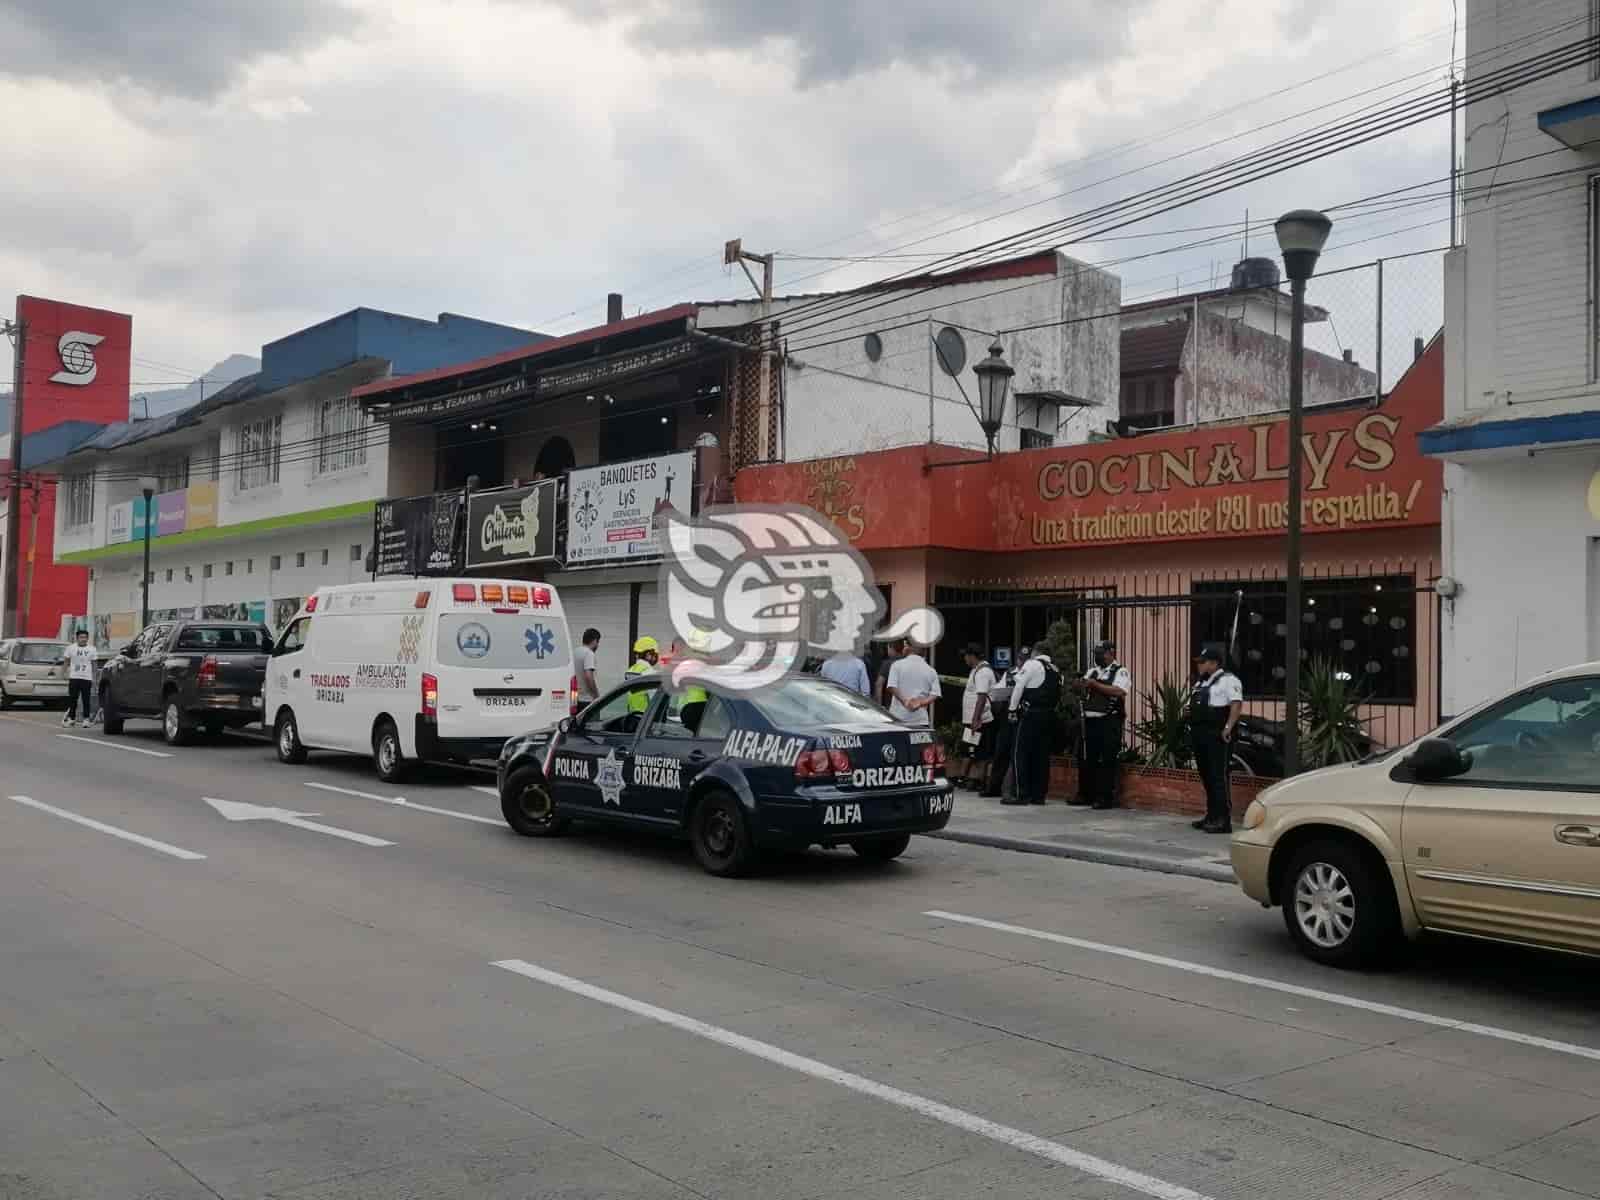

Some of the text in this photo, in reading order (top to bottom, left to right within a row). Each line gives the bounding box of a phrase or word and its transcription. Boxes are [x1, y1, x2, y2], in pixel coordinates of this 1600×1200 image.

[600, 462, 657, 487] BANQUETES
[618, 488, 636, 509] LyS
[1031, 511, 1069, 545] Una
[1071, 502, 1152, 542] tradición
[1154, 501, 1212, 537] desde
[1215, 495, 1251, 533] 1981
[310, 674, 351, 688] TRASLADOS
[356, 664, 407, 679] AMBULANCIA
[316, 688, 345, 704] ORIZABA
[485, 697, 527, 707] ORIZABA
[830, 735, 863, 749] POLICIA
[555, 757, 589, 779] POLICIA
[634, 754, 682, 770] MUNICIPAL
[633, 765, 681, 790] ORIZABA
[852, 766, 926, 787] ORIZABA
[823, 803, 862, 825] ALFA
